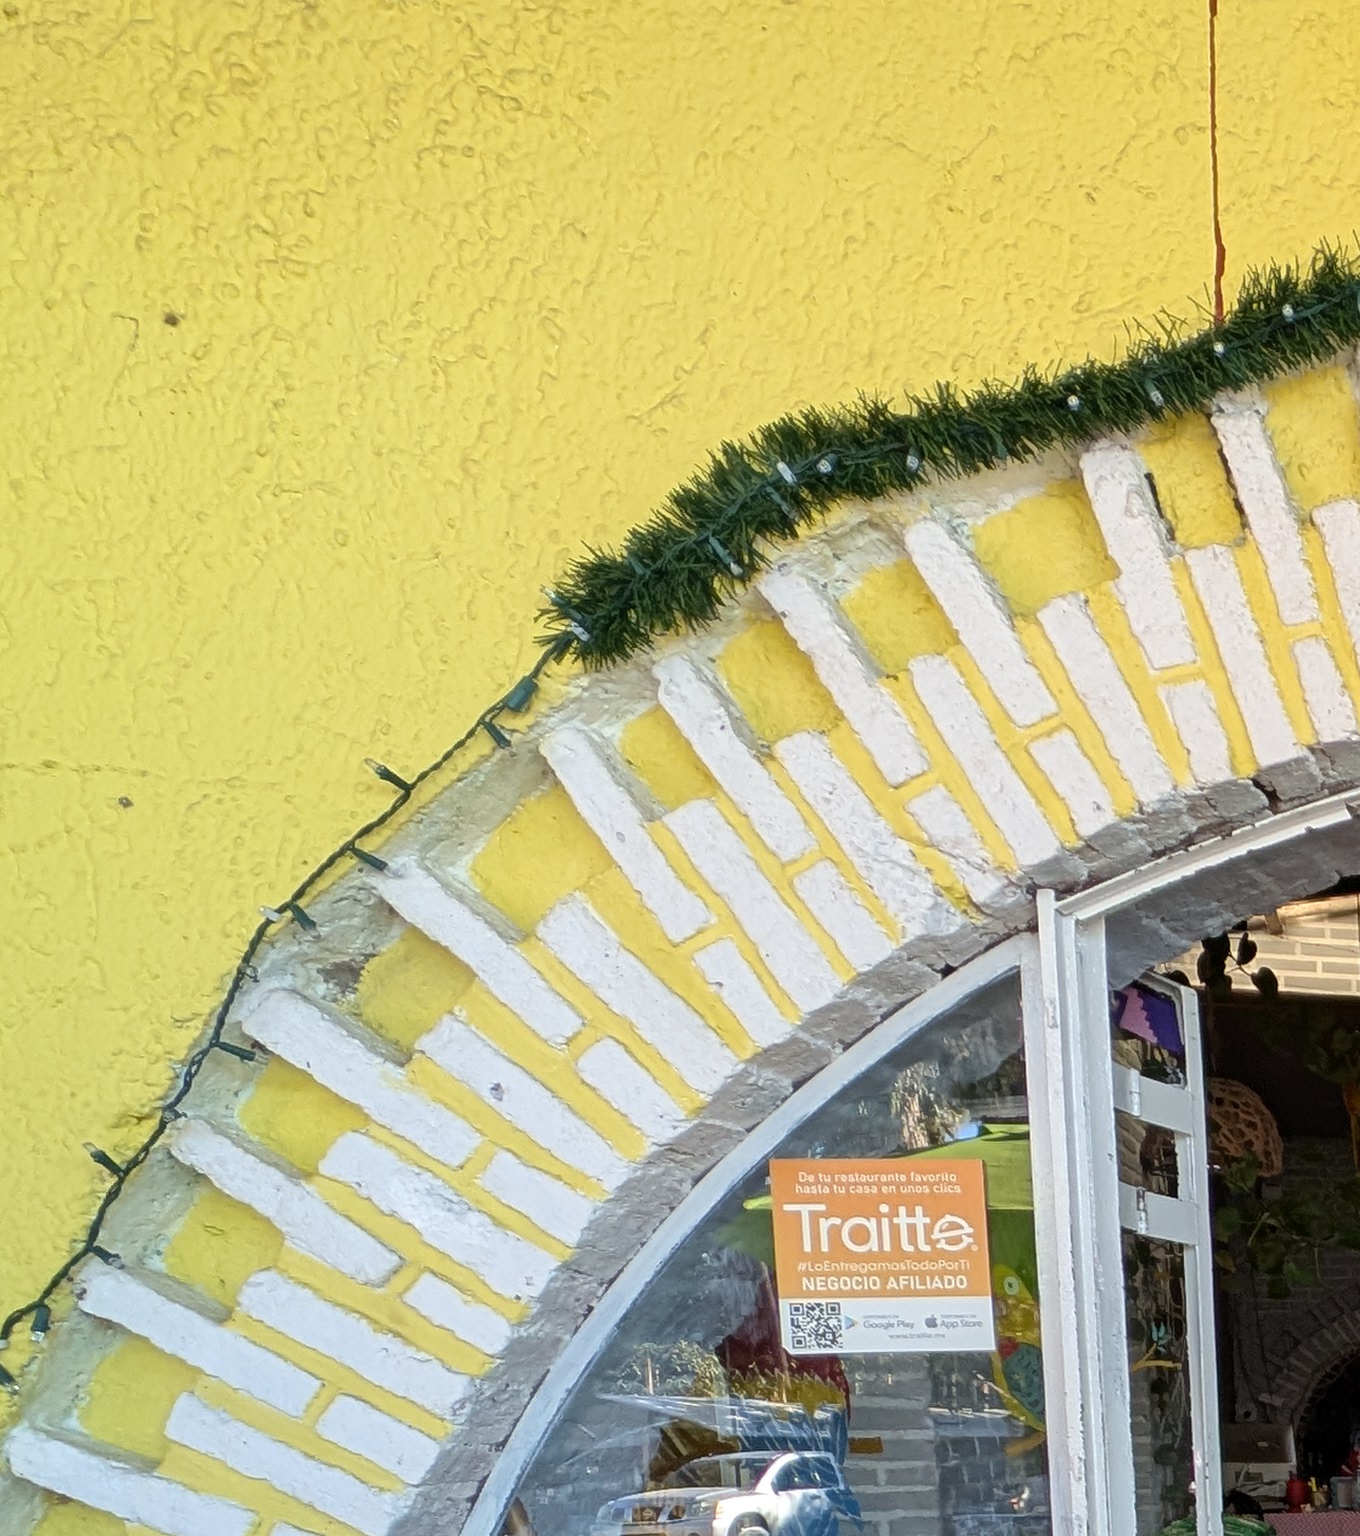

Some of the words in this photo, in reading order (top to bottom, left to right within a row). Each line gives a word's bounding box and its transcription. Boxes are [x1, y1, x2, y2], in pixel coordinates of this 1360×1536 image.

[798, 1171, 815, 1183] De
[818, 1172, 831, 1183] tu
[834, 1172, 907, 1183] restaurante
[910, 1171, 957, 1182] favorito
[795, 1184, 830, 1195] hasta
[833, 1184, 846, 1194] tu
[849, 1185, 877, 1194] casa
[882, 1185, 896, 1194] en
[900, 1185, 930, 1194] unos
[933, 1183, 962, 1194] clics
[797, 1259, 970, 1274] #LoEntregamosTodoPorTi
[802, 1276, 881, 1291] NEGOCIO
[886, 1274, 968, 1290] AFILIADO
[862, 1319, 895, 1331] Google
[896, 1319, 916, 1330] Play
[939, 1319, 959, 1330] App
[959, 1319, 984, 1329] Store
